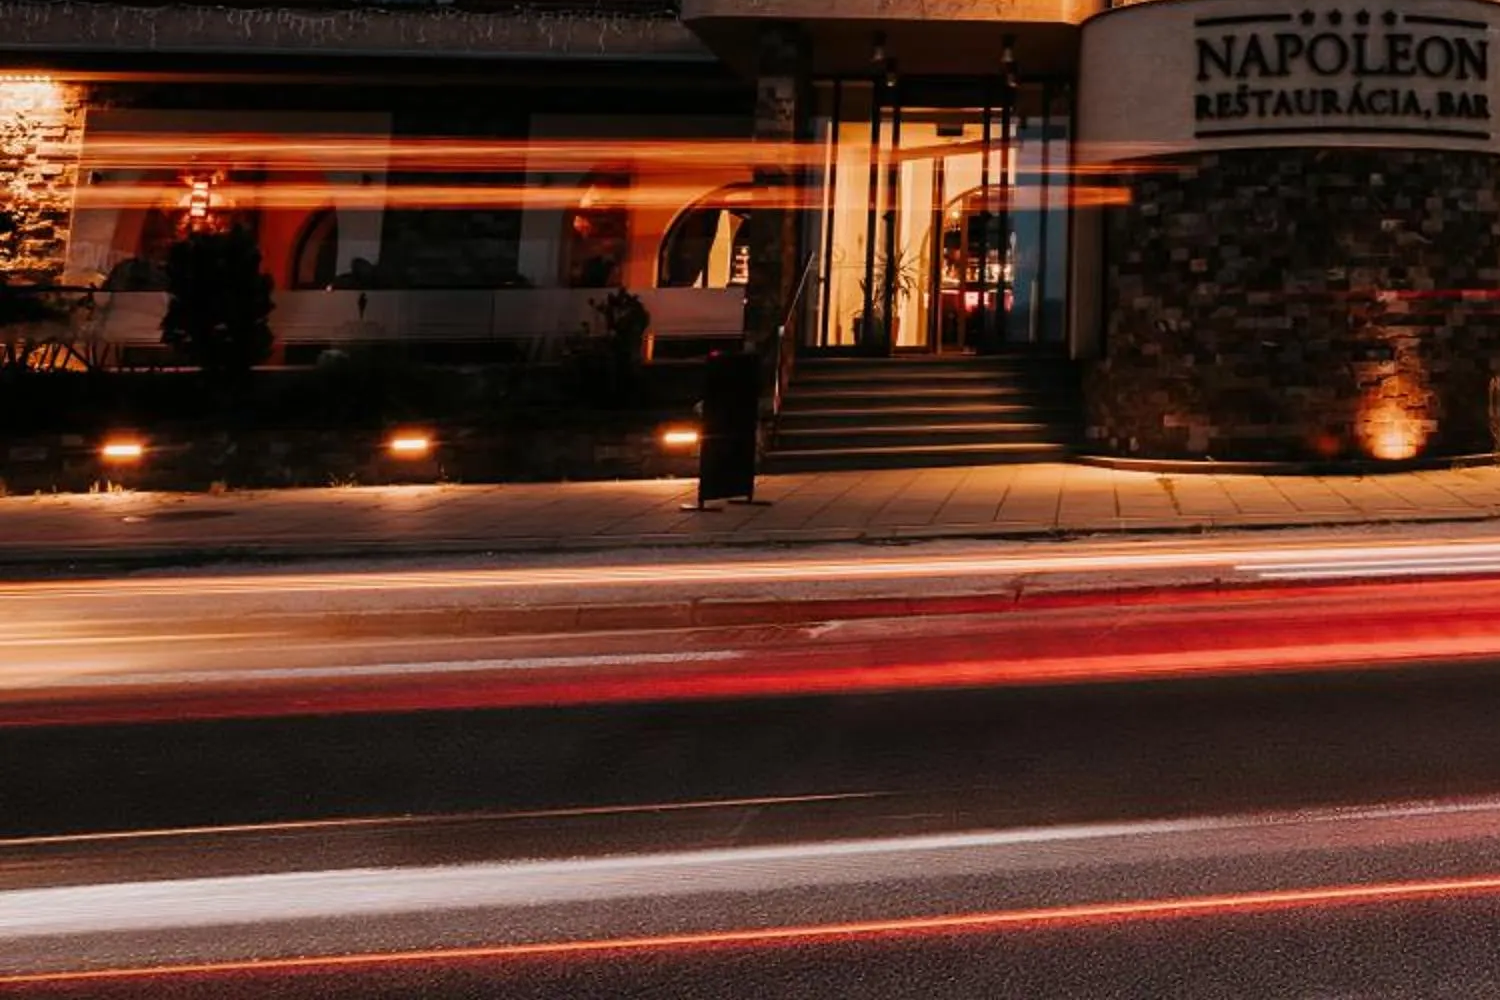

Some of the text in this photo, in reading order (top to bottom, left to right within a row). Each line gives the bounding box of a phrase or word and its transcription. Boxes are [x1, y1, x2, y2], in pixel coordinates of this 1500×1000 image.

[1195, 33, 1488, 80] NAPOLEON
[1195, 83, 1490, 120] REŠTAURÁCIA, BAR
